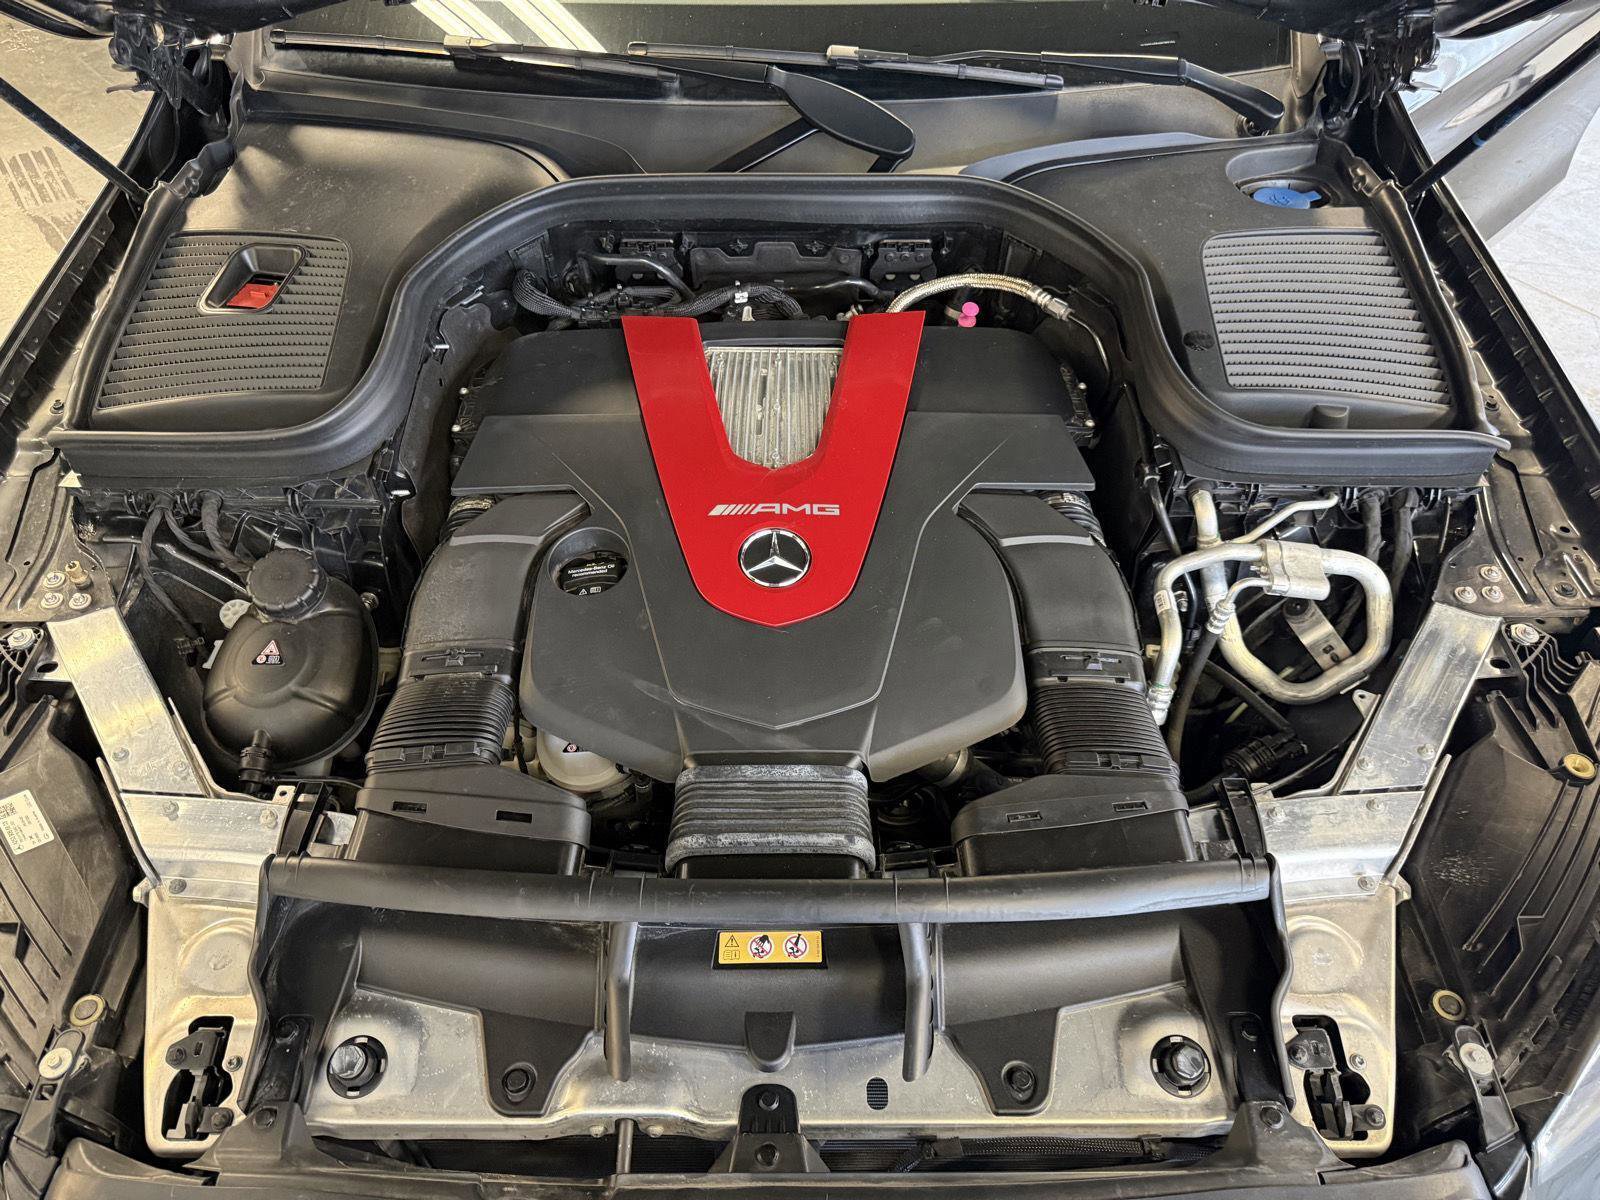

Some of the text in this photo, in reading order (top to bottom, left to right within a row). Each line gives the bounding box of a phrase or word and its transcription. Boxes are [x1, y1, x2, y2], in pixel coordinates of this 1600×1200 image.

[750, 503, 840, 516] AMG
[568, 565, 606, 574] Mercedes-Benz
[572, 569, 607, 577] recommended
